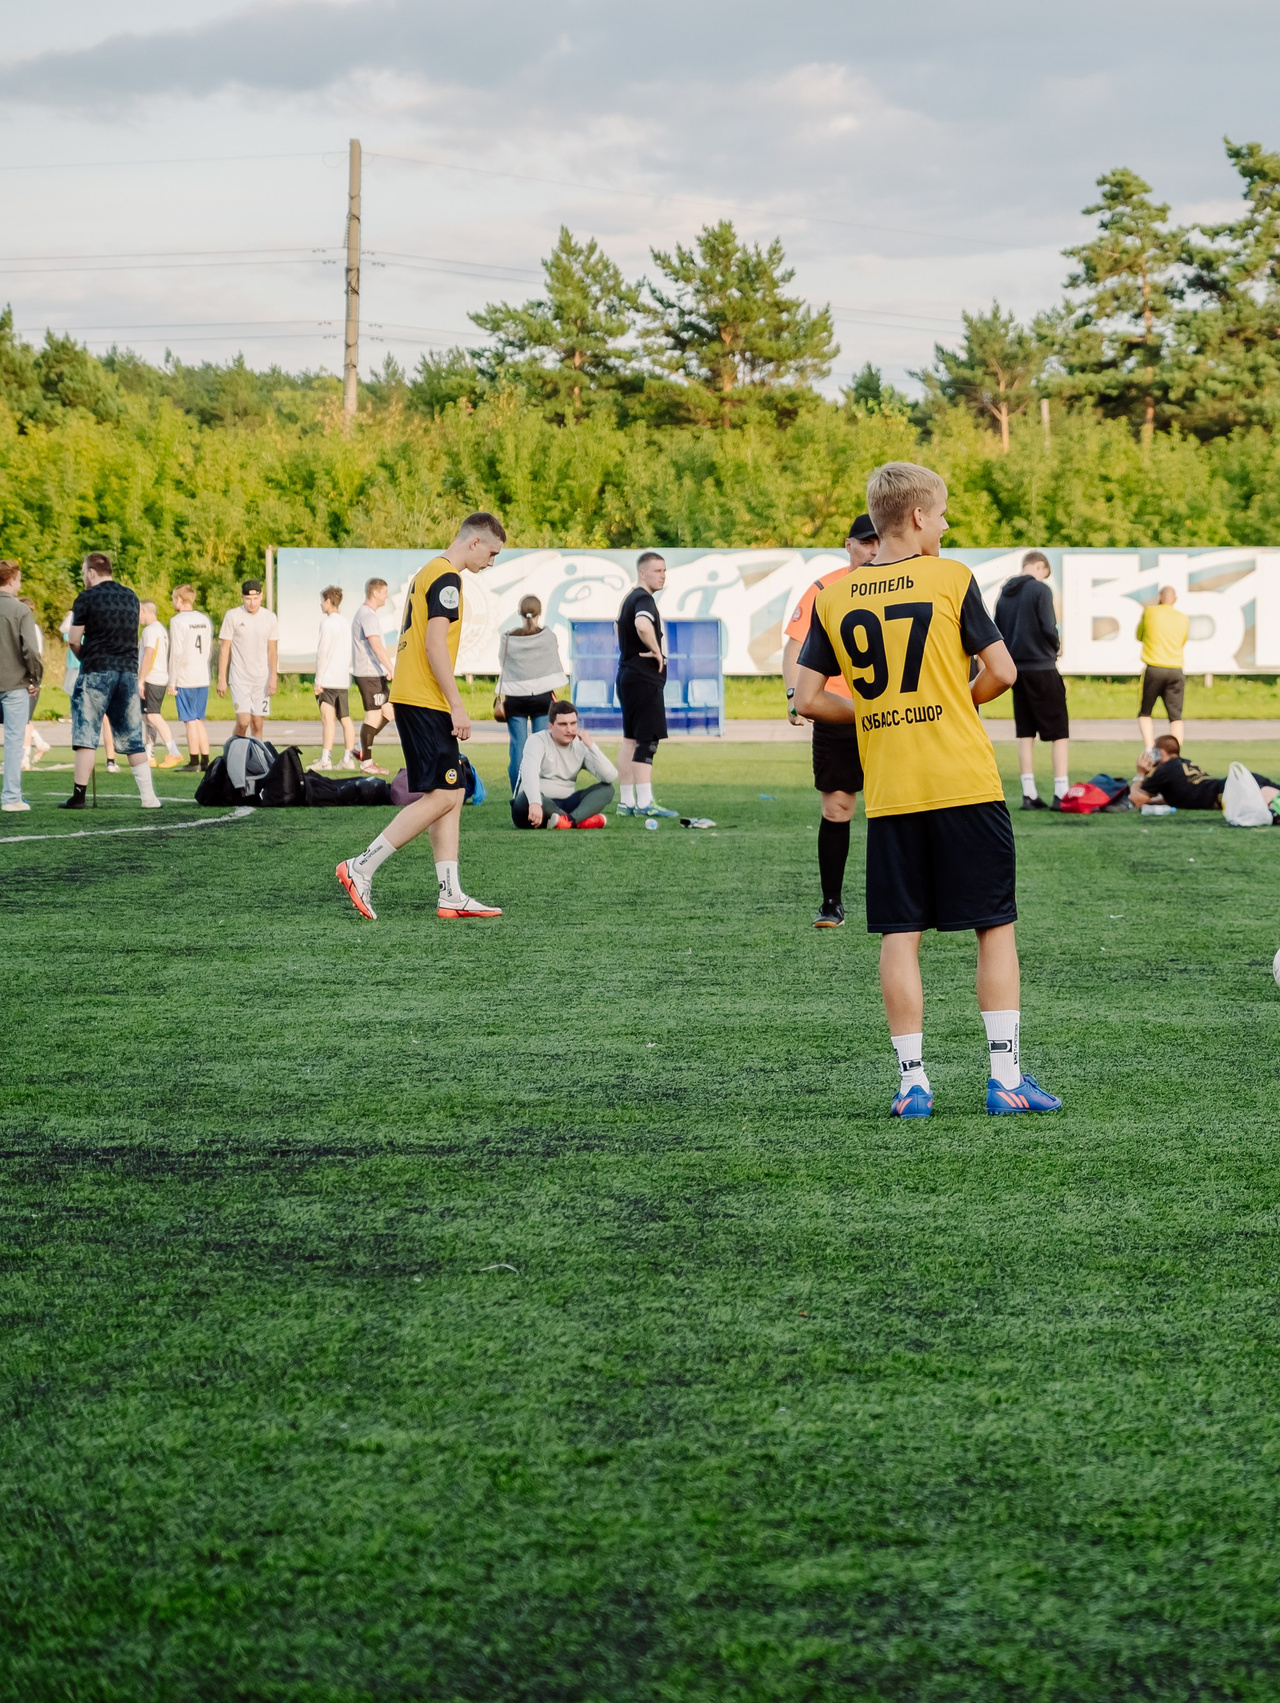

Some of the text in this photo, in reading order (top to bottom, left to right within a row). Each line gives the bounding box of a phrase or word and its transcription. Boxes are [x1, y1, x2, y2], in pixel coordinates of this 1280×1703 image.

[851, 575, 914, 597] РОППЕЛЬ
[194, 634, 202, 654] 4
[840, 601, 933, 700] 97
[262, 700, 268, 713] 2
